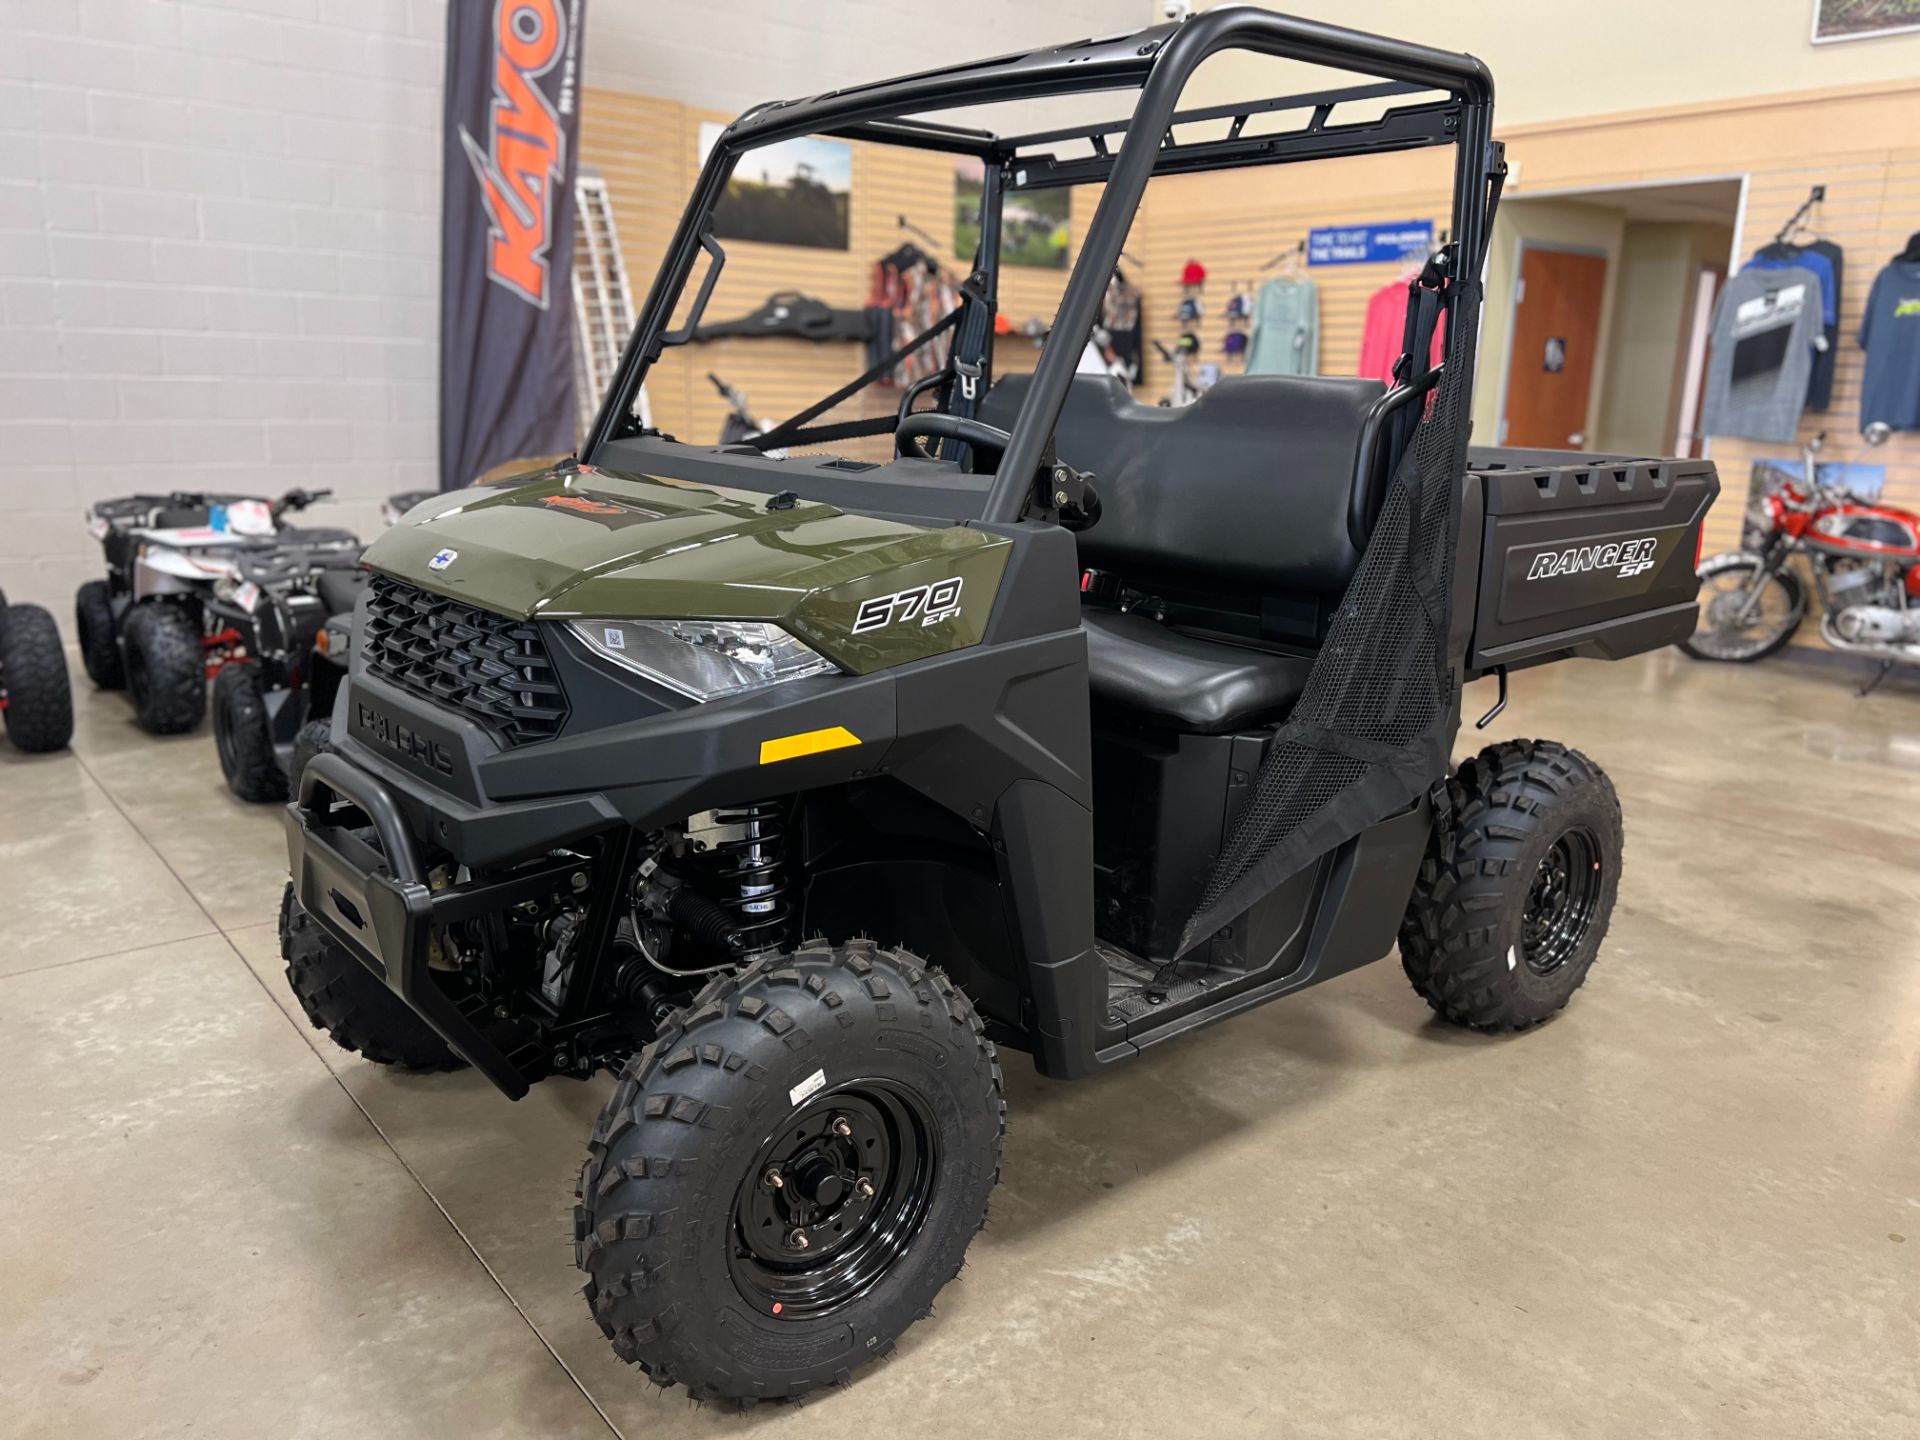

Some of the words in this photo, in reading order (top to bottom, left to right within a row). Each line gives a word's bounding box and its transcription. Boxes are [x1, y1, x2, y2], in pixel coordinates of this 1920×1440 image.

[1527, 537, 1657, 580] RANGER
[1616, 560, 1656, 579] SP
[851, 576, 963, 635] 570
[921, 606, 962, 628] EFI
[358, 702, 453, 778] POLARIS
